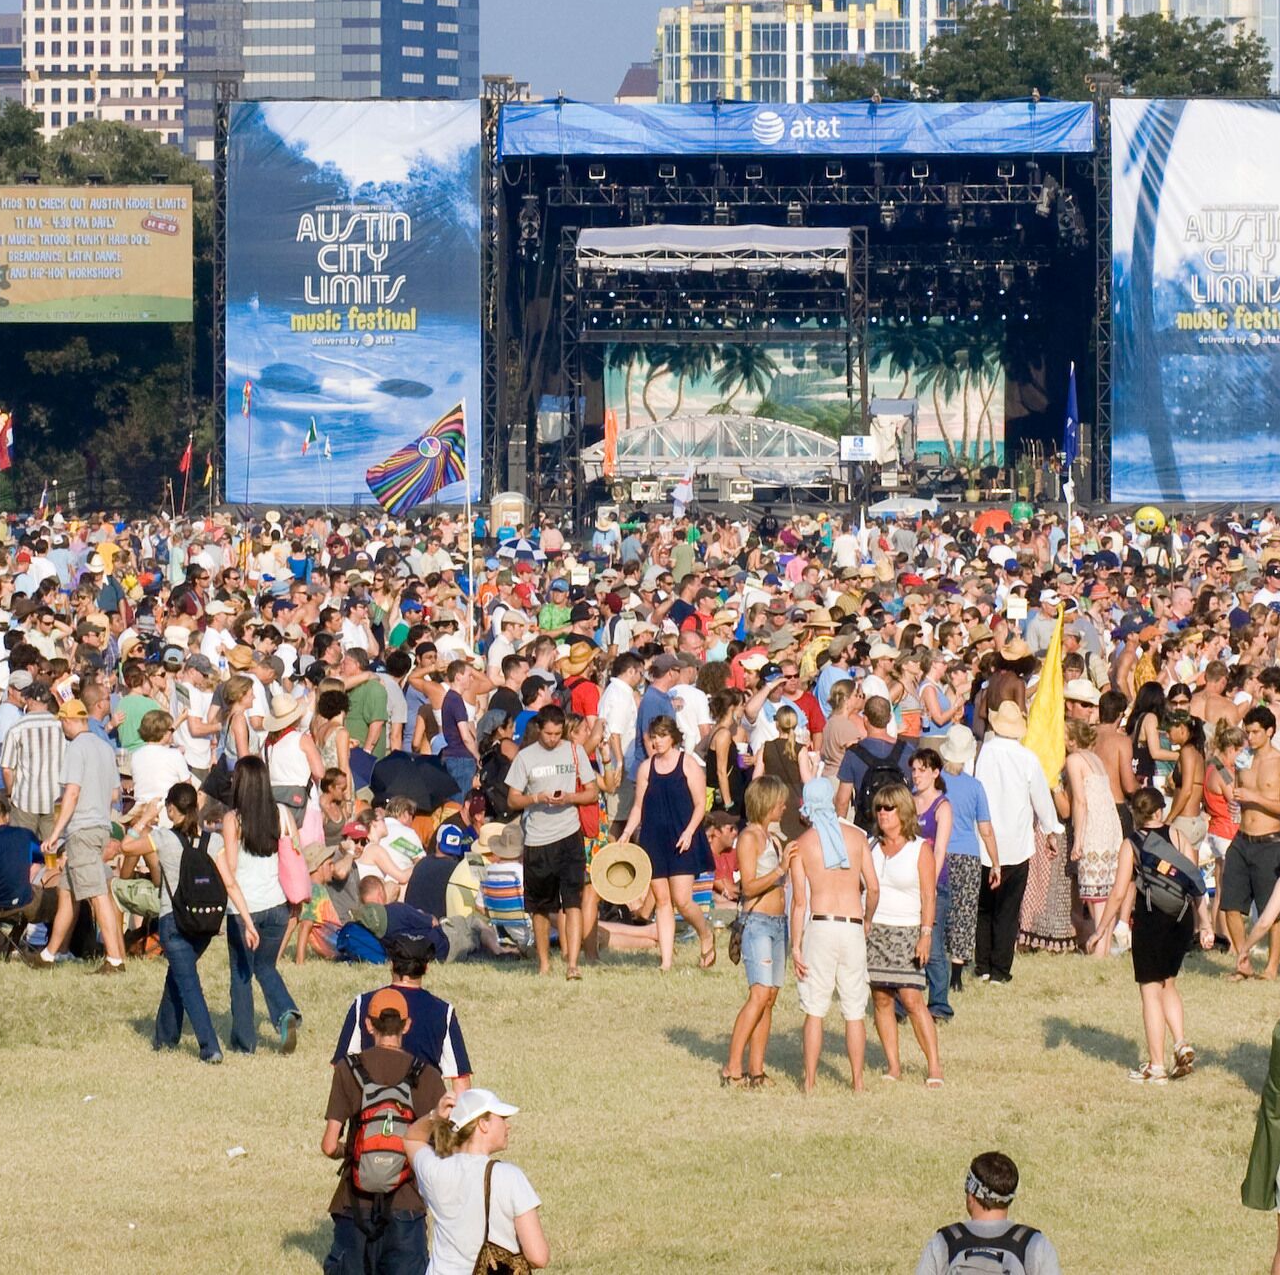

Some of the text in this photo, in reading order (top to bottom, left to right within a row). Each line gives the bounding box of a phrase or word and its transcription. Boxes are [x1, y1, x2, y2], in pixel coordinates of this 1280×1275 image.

[790, 116, 841, 138] at&t
[25, 197, 37, 210] TO
[39, 197, 67, 210] CHECK
[70, 197, 86, 210] OUT
[15, 216, 24, 228] 11
[27, 216, 43, 228] AM
[73, 216, 89, 228] PM
[296, 212, 412, 243] AUSTIN
[76, 234, 106, 246] FUNKY
[317, 243, 389, 273] CITY
[1204, 243, 1277, 273] CITY
[9, 267, 28, 279] AND
[304, 274, 407, 304] LIMITS
[290, 306, 417, 332] music festival
[1176, 308, 1228, 331] music
[312, 336, 349, 345] delivered
[350, 336, 360, 347] by
[1198, 335, 1235, 344] delivered
[1237, 335, 1246, 345] by
